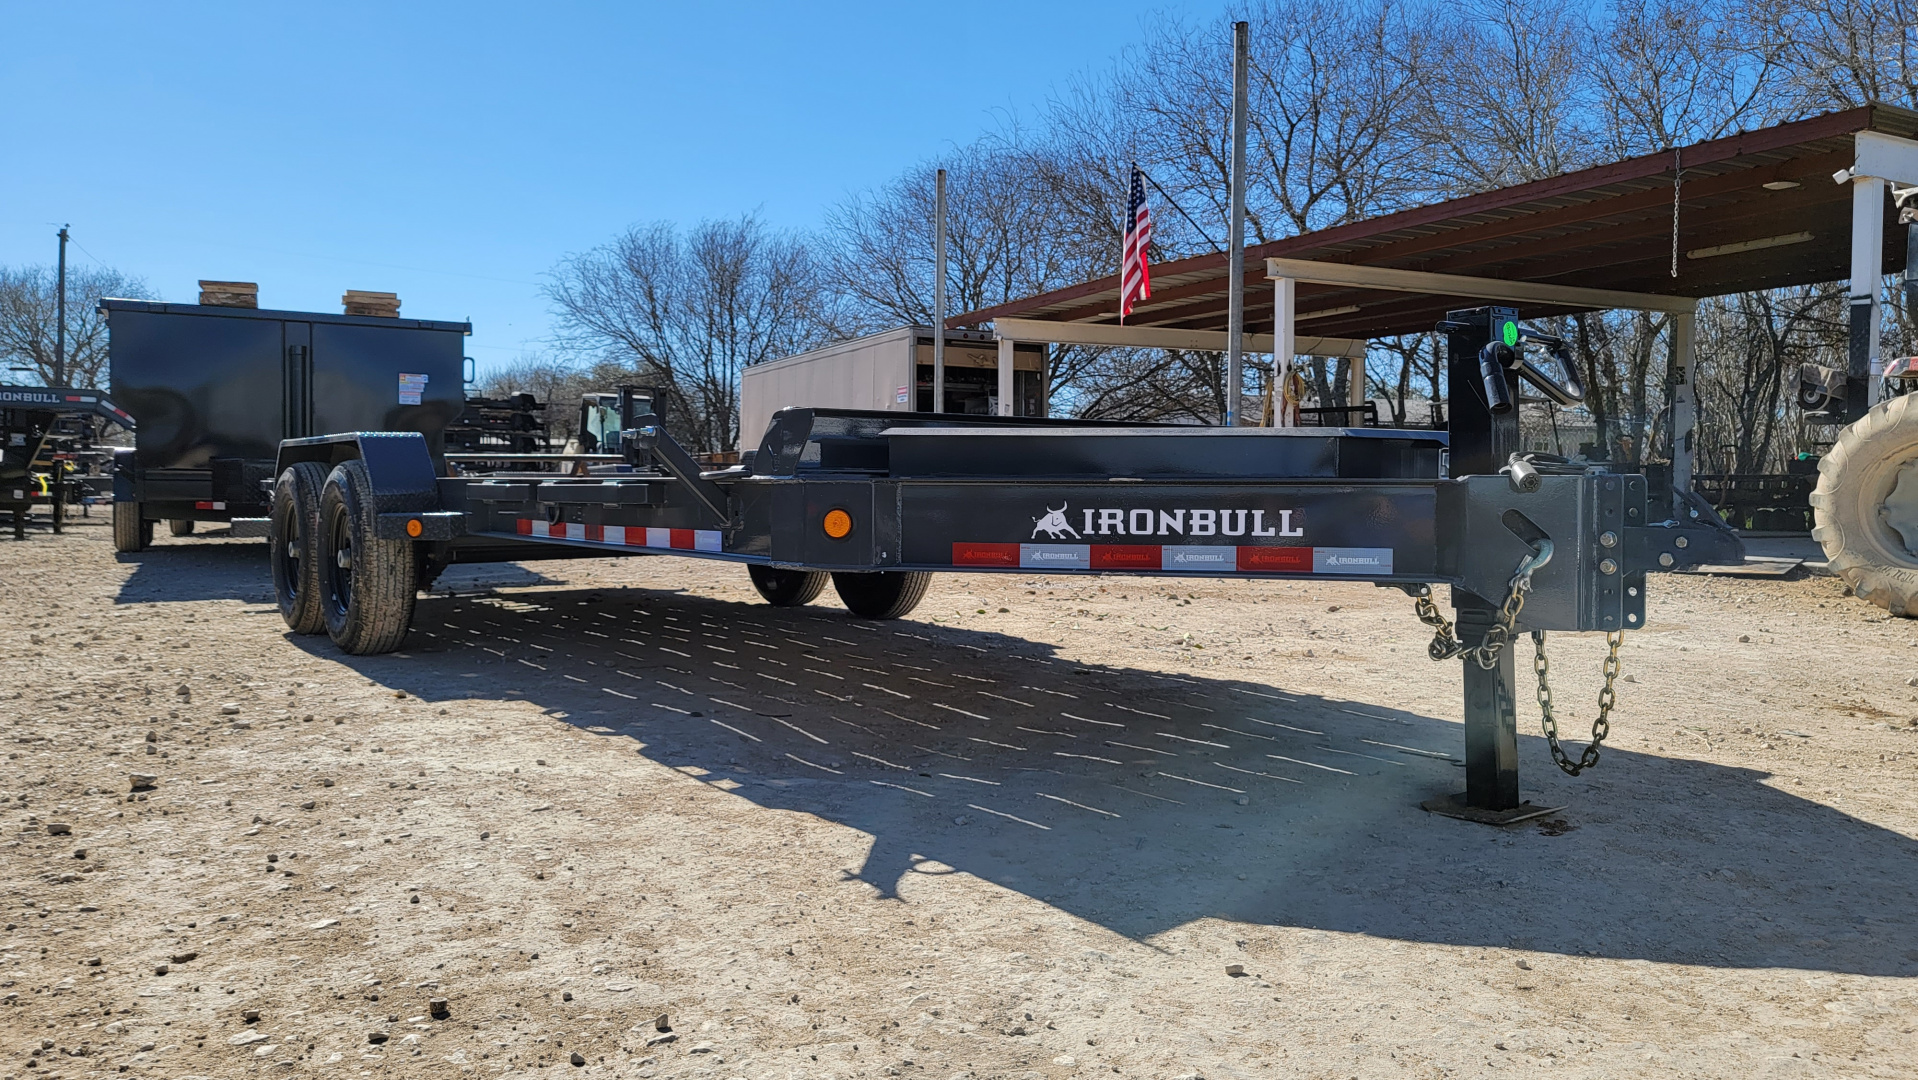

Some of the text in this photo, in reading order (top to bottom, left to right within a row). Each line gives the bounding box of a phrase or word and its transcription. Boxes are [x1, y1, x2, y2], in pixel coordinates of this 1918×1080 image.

[0, 391, 60, 403] ONBULL
[1082, 508, 1304, 537] IRONBULL
[1042, 552, 1079, 560] IRONBULL
[1113, 553, 1150, 561] IRONBULL
[1186, 554, 1224, 562] IRONBULL
[1262, 555, 1301, 564] IRONBULL
[1339, 557, 1380, 565] IRONBULL
